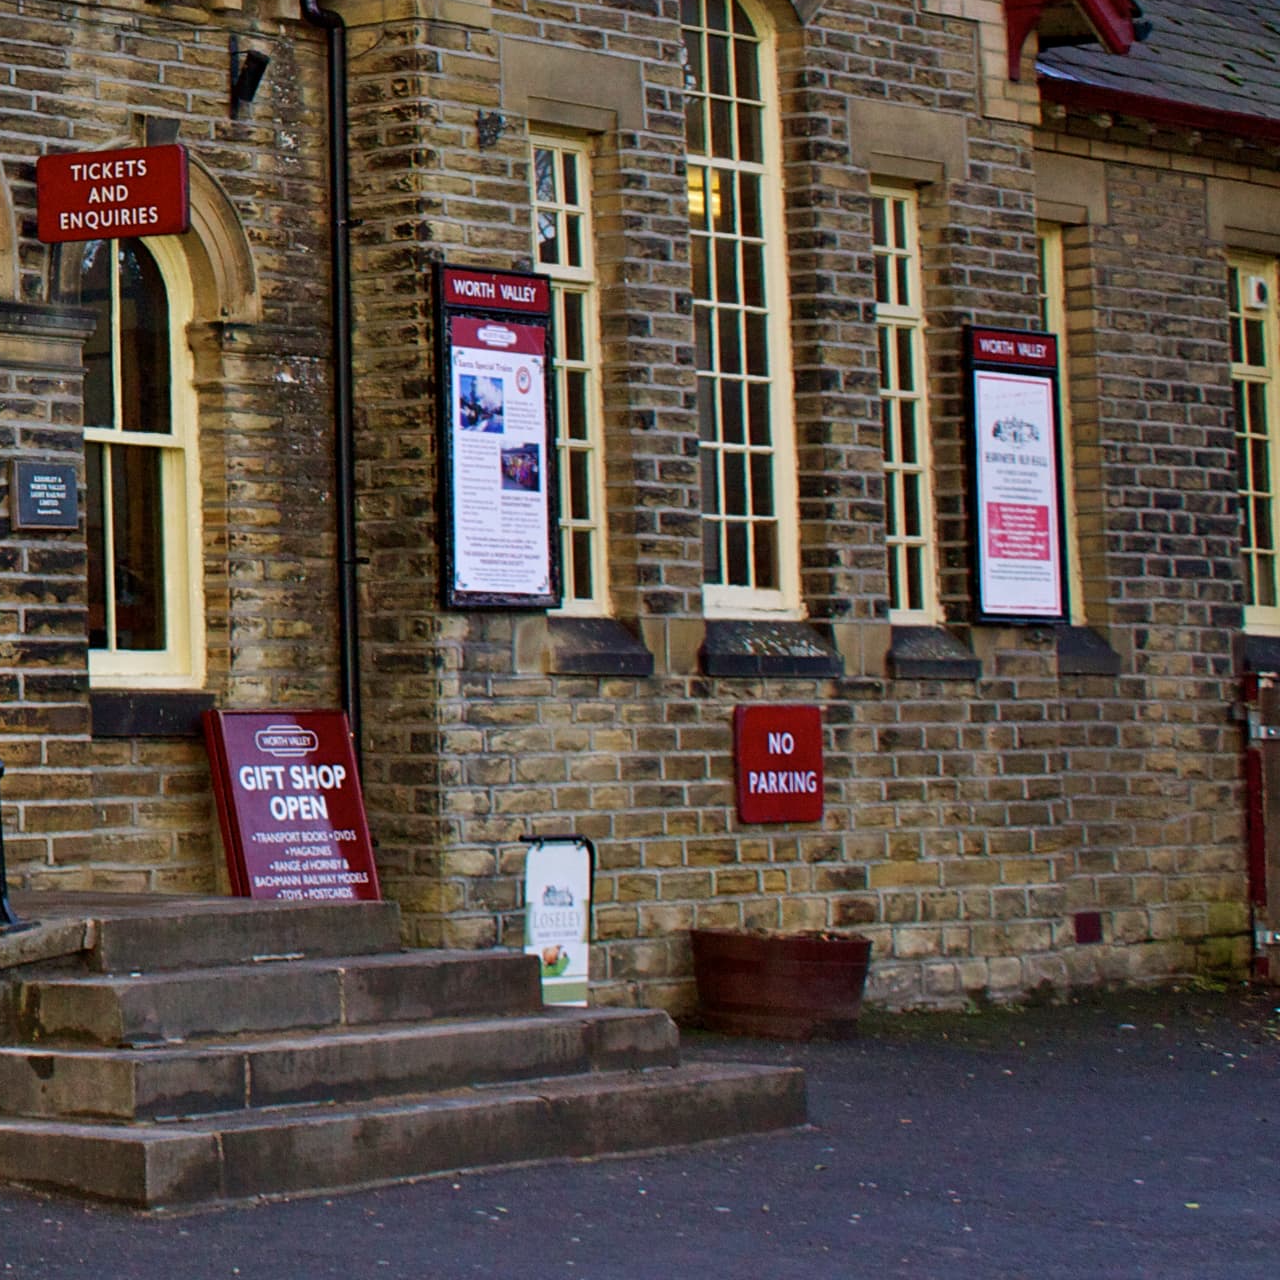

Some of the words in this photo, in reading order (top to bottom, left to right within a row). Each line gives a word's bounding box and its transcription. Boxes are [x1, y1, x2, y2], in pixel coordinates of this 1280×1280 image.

[70, 159, 147, 182] TICKETS
[88, 185, 129, 204] AND
[60, 206, 159, 230] ENQUIRIES
[453, 279, 496, 299] WORTH
[499, 284, 536, 303] VALLEY
[979, 338, 1015, 355] WORTH
[1017, 342, 1047, 358] VALLEY
[262, 736, 288, 745] WORTH
[289, 736, 311, 746] VALLEY
[768, 731, 795, 755] NO
[239, 765, 285, 791] GIFT
[289, 765, 346, 790] SHOP
[749, 771, 817, 794] PARKING
[270, 795, 329, 821] OPEN
[256, 831, 301, 843] TRANSPORT
[301, 831, 328, 842] BOOKS
[289, 845, 332, 857] MAGAZINES
[274, 860, 301, 872] RANGE
[310, 859, 342, 870] HORNBY
[343, 859, 350, 870] &
[302, 874, 339, 885] RAILWAY
[339, 872, 369, 884] MODELS
[281, 889, 303, 900] TOYS
[308, 888, 353, 899] POSTCARDS
